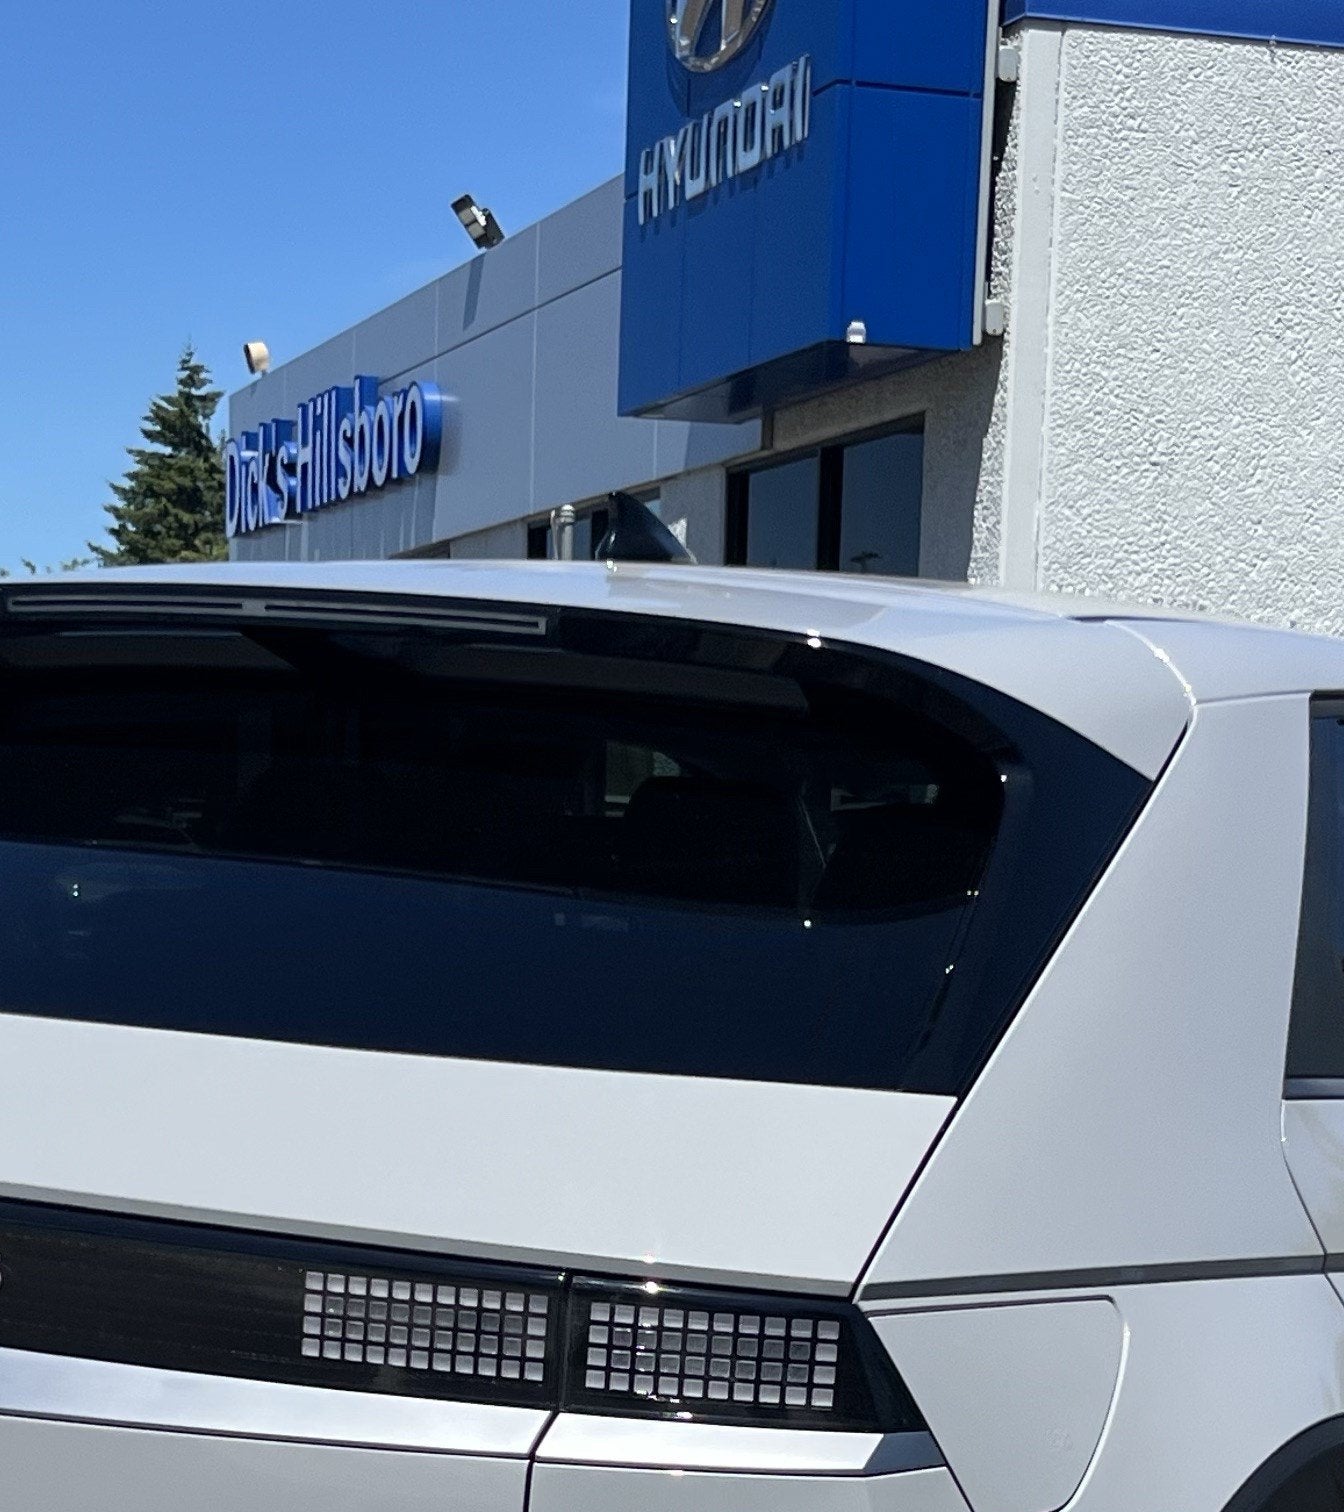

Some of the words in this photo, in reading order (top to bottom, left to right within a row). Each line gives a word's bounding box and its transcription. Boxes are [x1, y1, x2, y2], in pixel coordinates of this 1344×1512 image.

[638, 54, 812, 226] HYUNDAI
[225, 417, 290, 538] Dick's
[296, 375, 426, 515] Hillsboro
